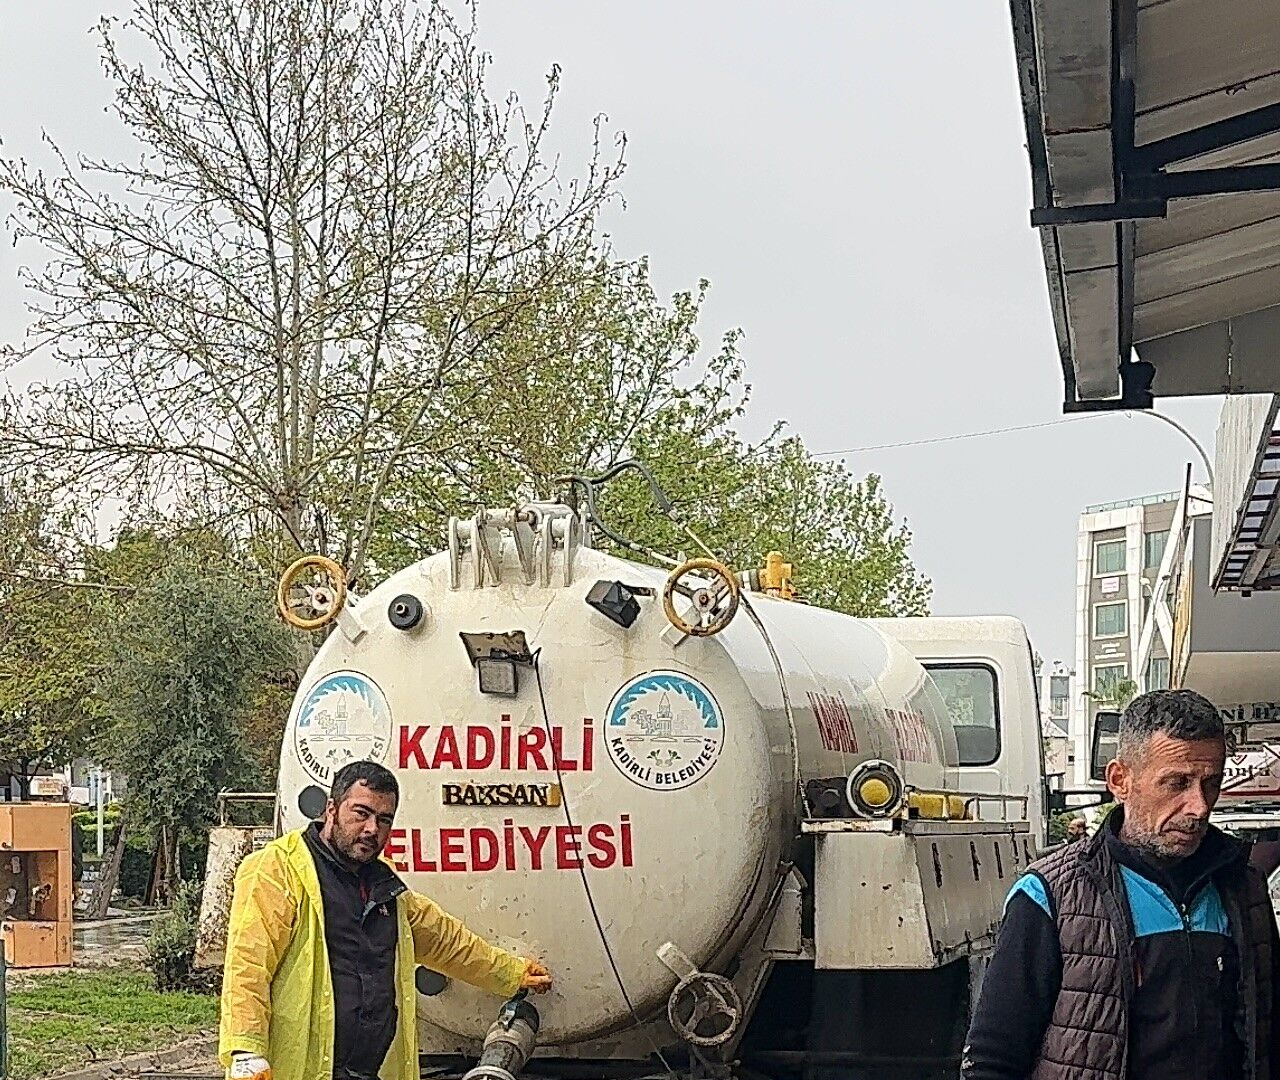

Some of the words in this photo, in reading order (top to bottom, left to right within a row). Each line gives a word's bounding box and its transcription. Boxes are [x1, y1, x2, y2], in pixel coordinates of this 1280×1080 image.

[298, 738, 330, 780] KADİRLİ
[398, 714, 594, 772] KADİRLİ
[610, 737, 652, 782] KADİRLİ
[655, 737, 718, 785] BELEDİYESİ
[442, 784, 549, 805] BAKSAN
[384, 813, 634, 872] ELEDİYESİ
